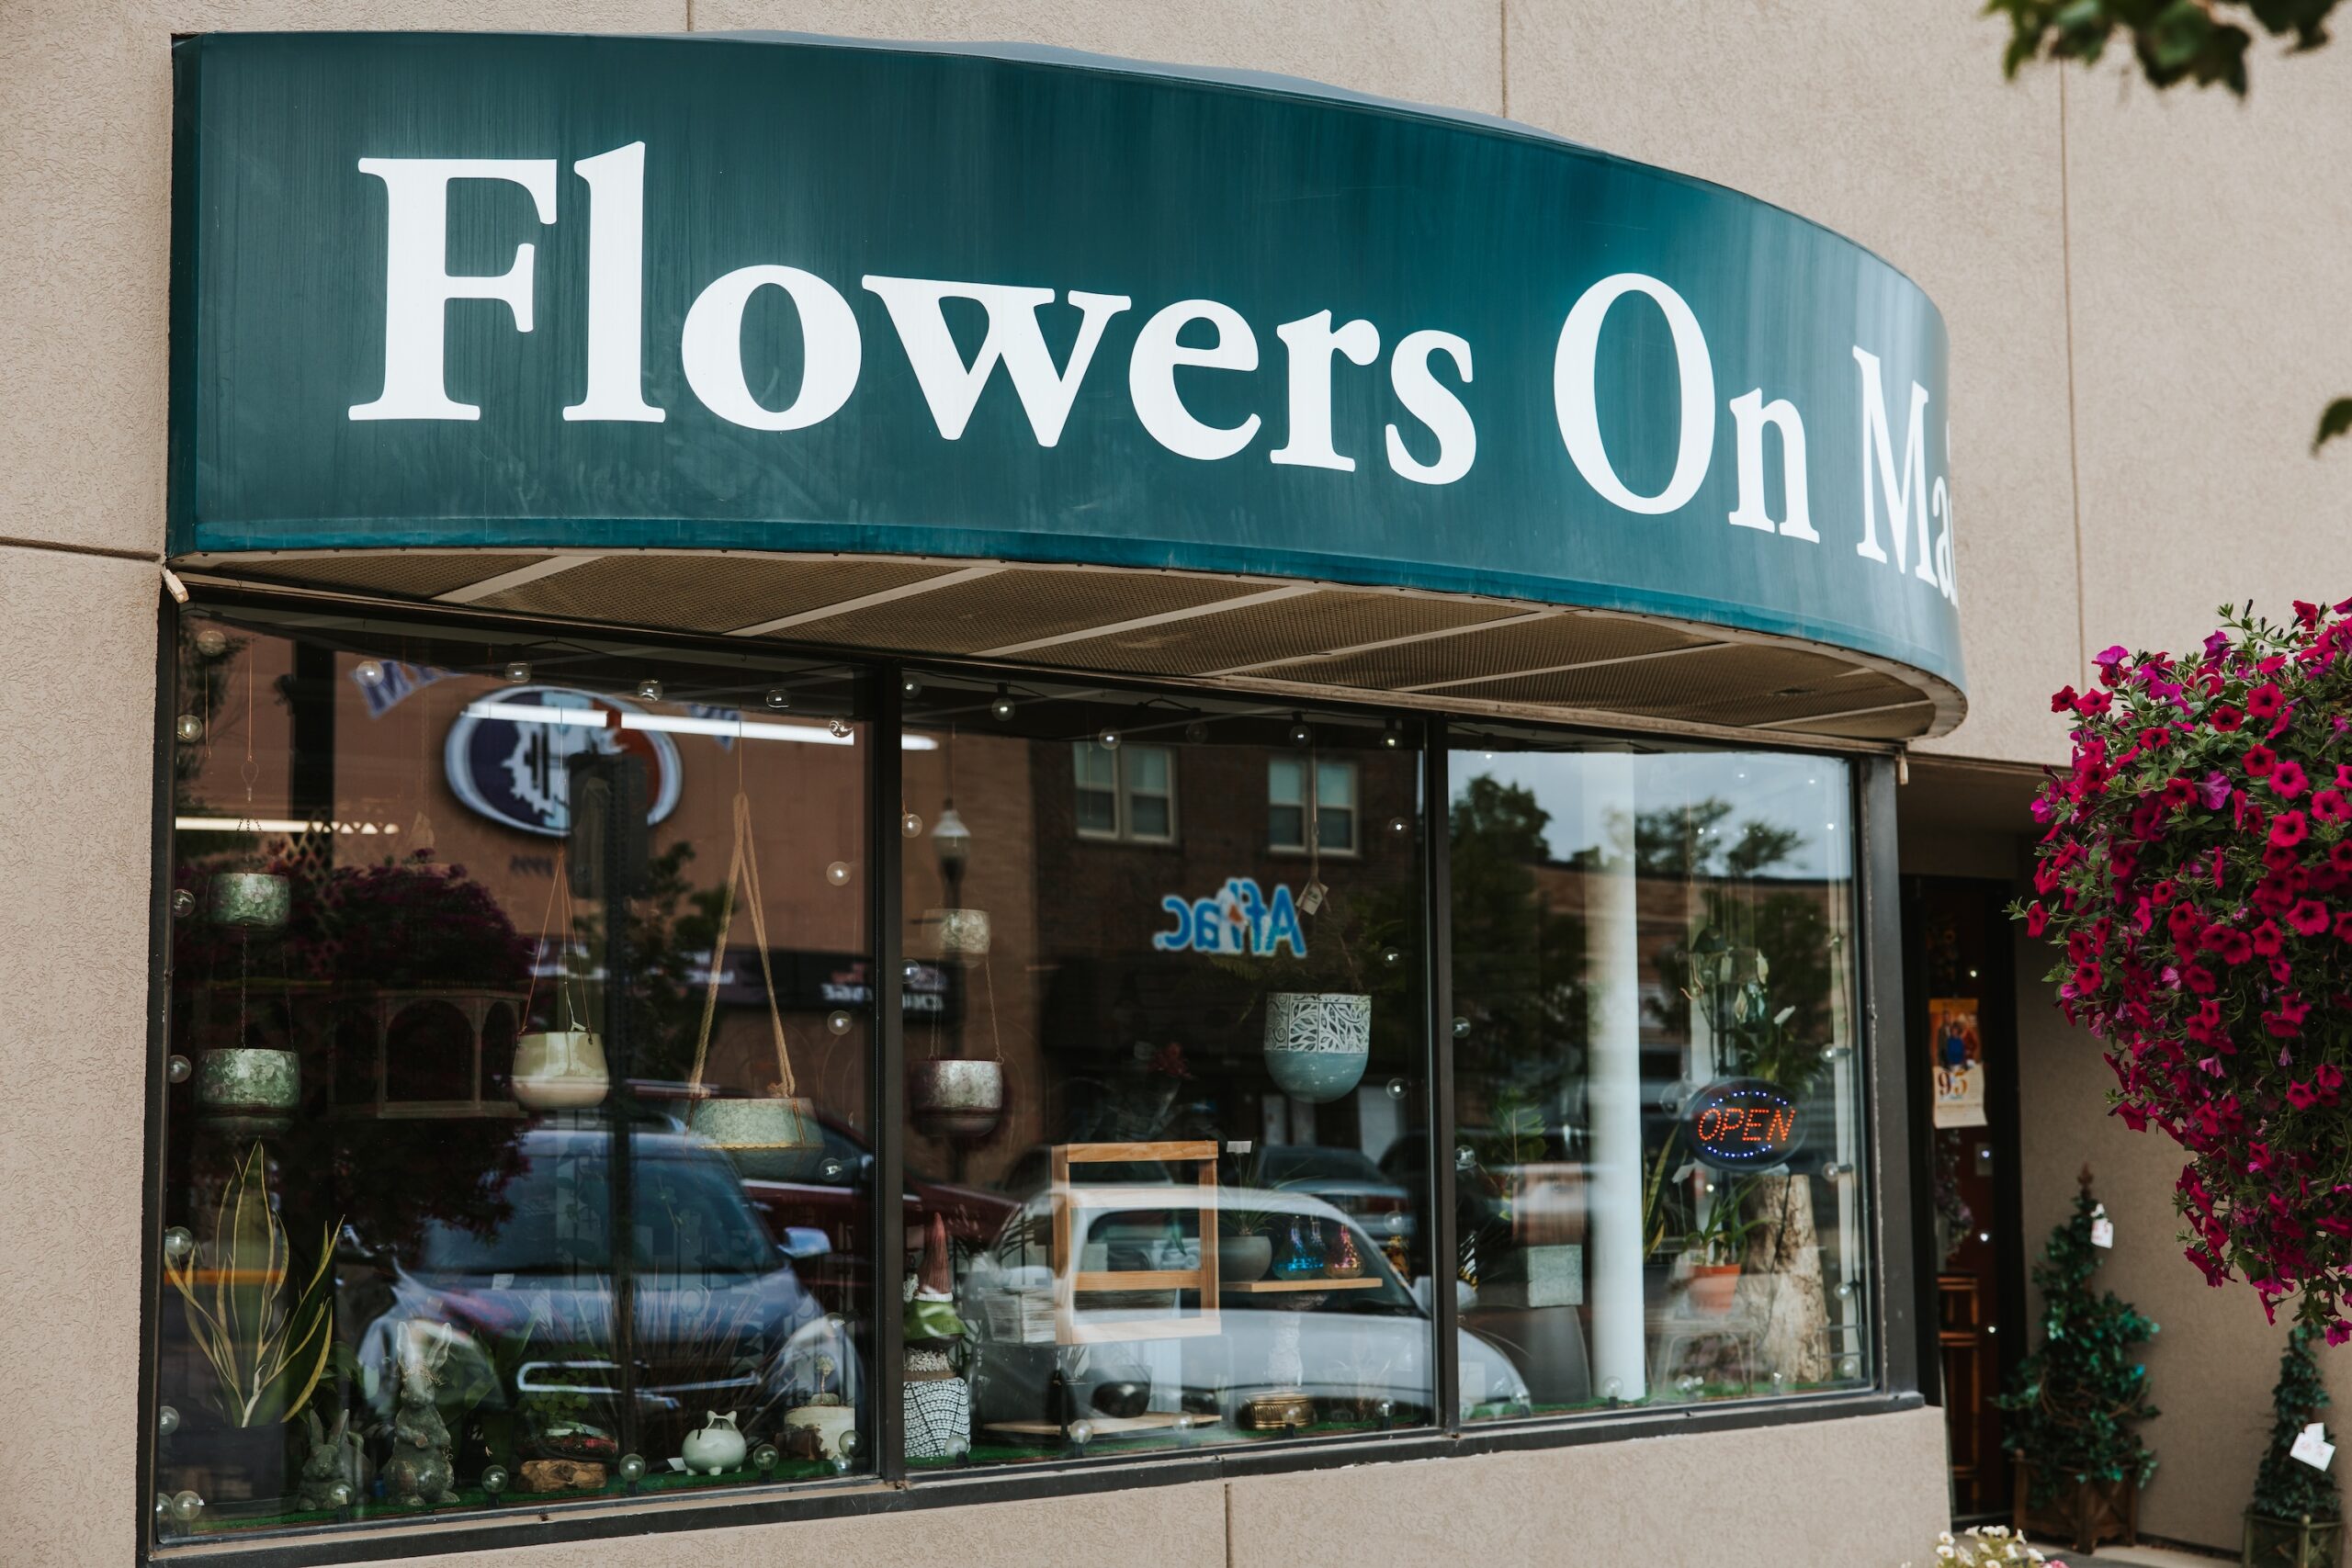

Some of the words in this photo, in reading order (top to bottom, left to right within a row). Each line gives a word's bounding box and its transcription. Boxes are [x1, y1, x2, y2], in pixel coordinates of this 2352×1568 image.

[347, 141, 1477, 486] Flowers
[1553, 272, 1821, 545] On
[1852, 344, 1960, 614] Ma
[1698, 1107, 1797, 1142] OPEN
